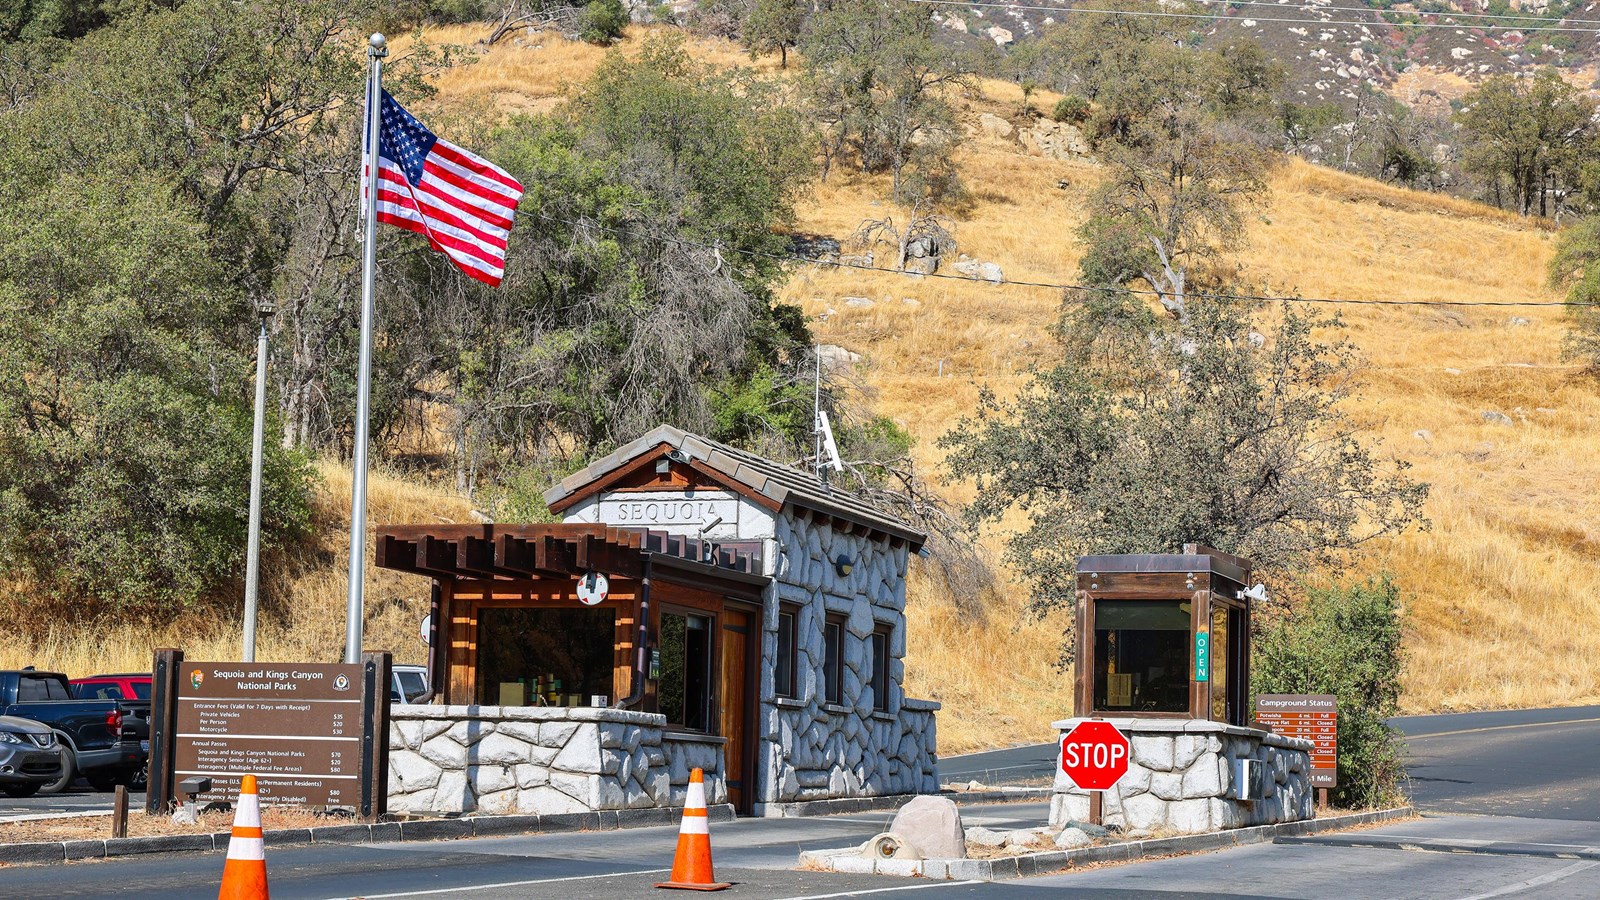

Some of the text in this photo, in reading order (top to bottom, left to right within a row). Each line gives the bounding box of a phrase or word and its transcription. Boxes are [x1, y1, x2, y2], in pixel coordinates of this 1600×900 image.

[618, 502, 718, 522] SEQUOIA
[1198, 638, 1206, 676] OPEN
[214, 670, 323, 680] Sequoia and Kings Canyon
[274, 682, 296, 690] Parks
[1260, 700, 1306, 708] Campground
[1066, 742, 1124, 769] STOP
